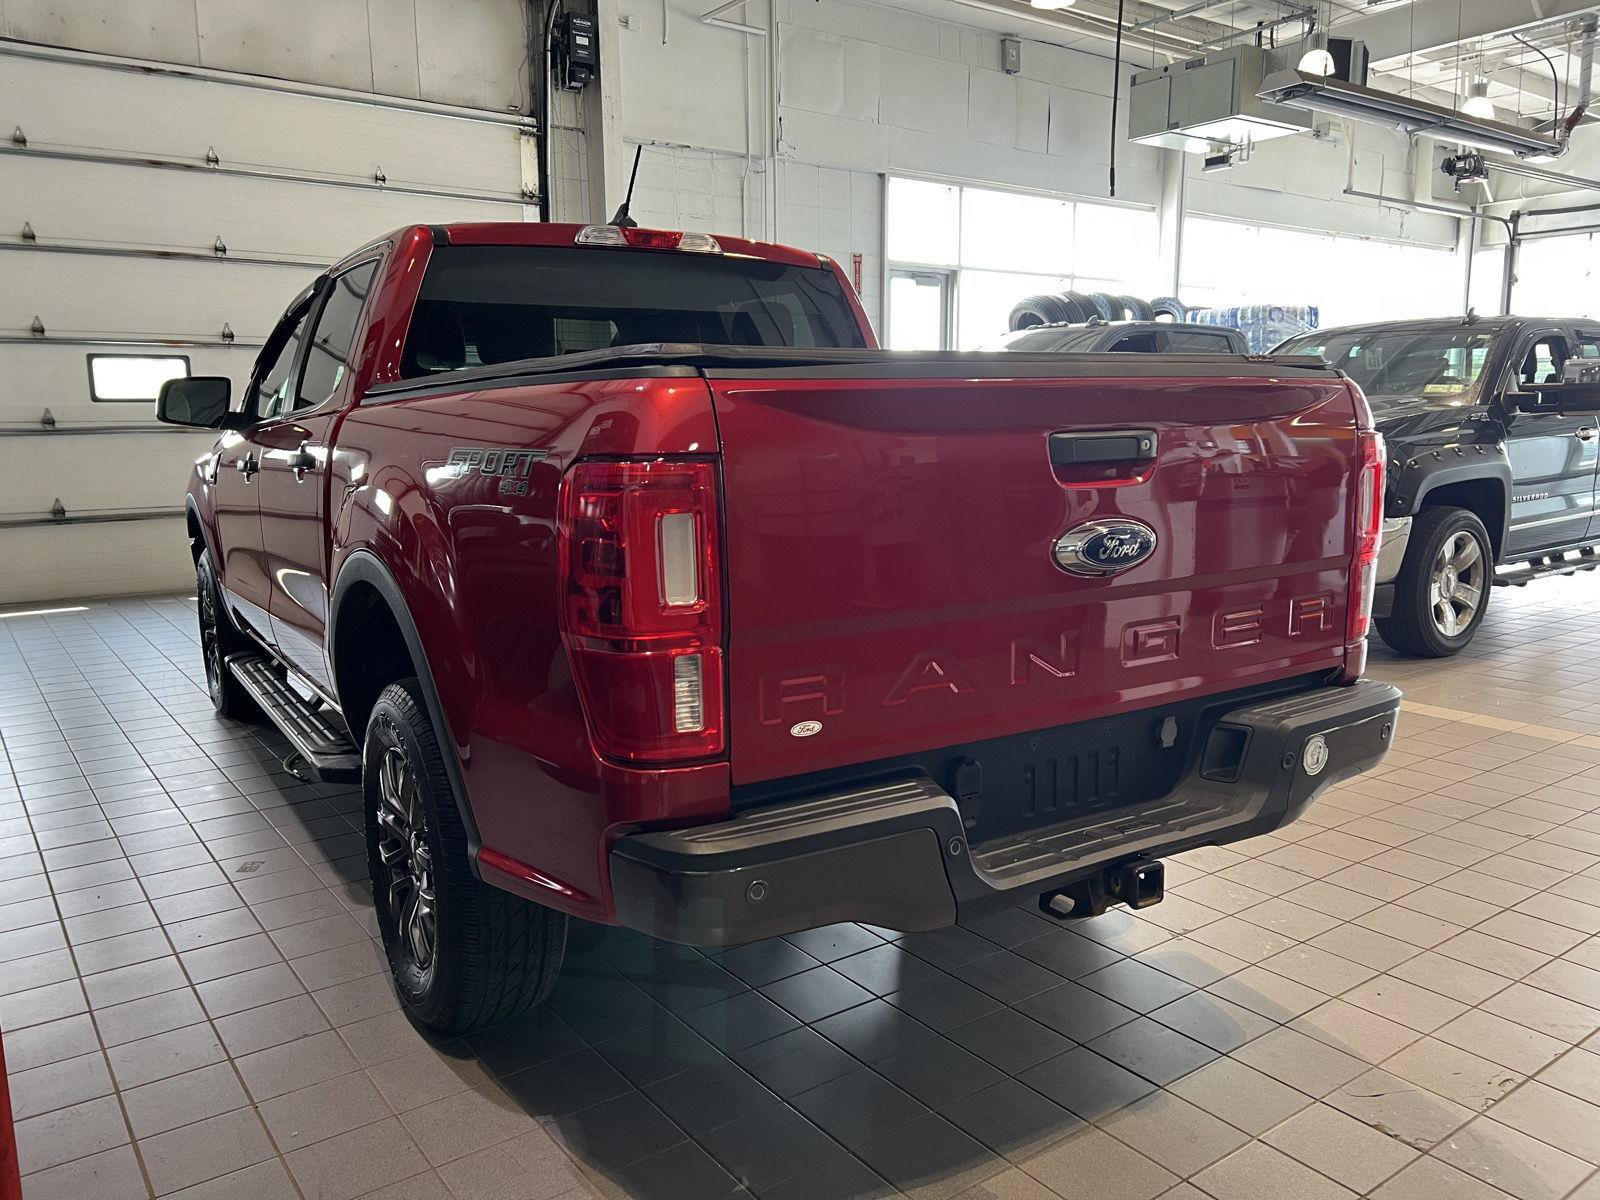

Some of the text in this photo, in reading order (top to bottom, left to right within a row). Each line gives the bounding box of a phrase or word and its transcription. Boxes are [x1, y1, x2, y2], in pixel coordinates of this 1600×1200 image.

[447, 447, 549, 478] SPORT
[1099, 534, 1141, 560] Ford
[758, 594, 1334, 726] RANGER
